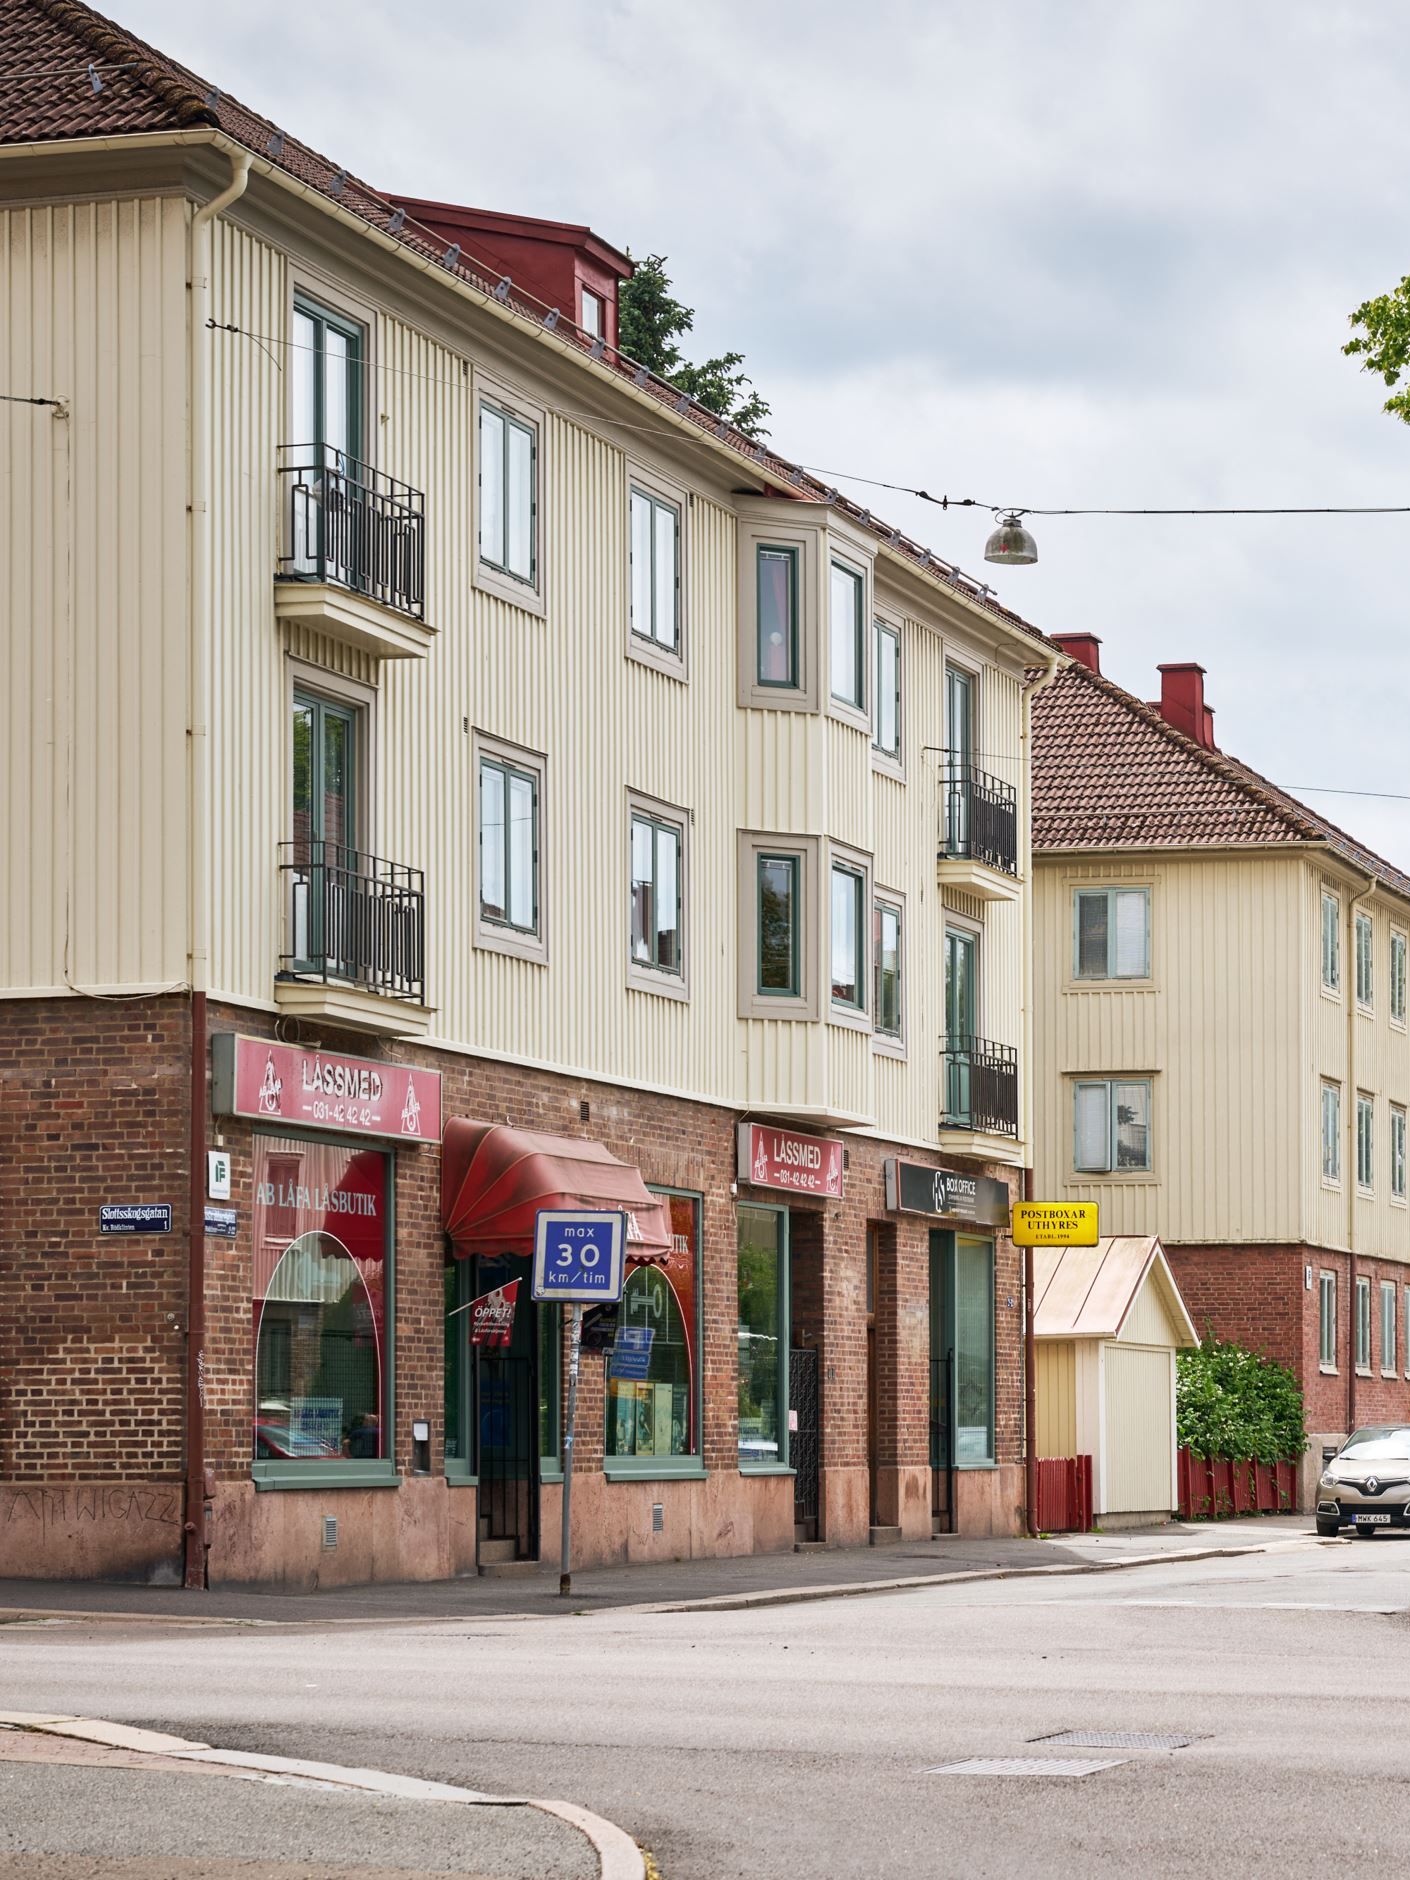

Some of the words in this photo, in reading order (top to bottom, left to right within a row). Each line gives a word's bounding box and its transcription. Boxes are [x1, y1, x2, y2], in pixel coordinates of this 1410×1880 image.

[302, 1054, 383, 1101] LÅSSMED
[347, 1107, 358, 1124] 42
[359, 1109, 371, 1126] 42
[774, 1133, 821, 1169] LÅSSMED
[800, 1173, 808, 1187] 42
[808, 1175, 815, 1188] 42
[946, 1177, 958, 1193] BOX
[958, 1179, 976, 1195] OFFICE
[256, 1182, 275, 1206] AB
[278, 1178, 311, 1209] LÅFA
[315, 1183, 377, 1217] LÅSBUTIK
[101, 1207, 168, 1221] Slottsskogsgatan
[1021, 1209, 1086, 1219] POSTBOXAR
[163, 1221, 168, 1230] 1
[564, 1227, 595, 1238] max
[1028, 1221, 1079, 1230] UTHYRES
[555, 1243, 600, 1268] 30
[549, 1271, 606, 1284] km/tim
[474, 1305, 512, 1318] ÖPPET!
